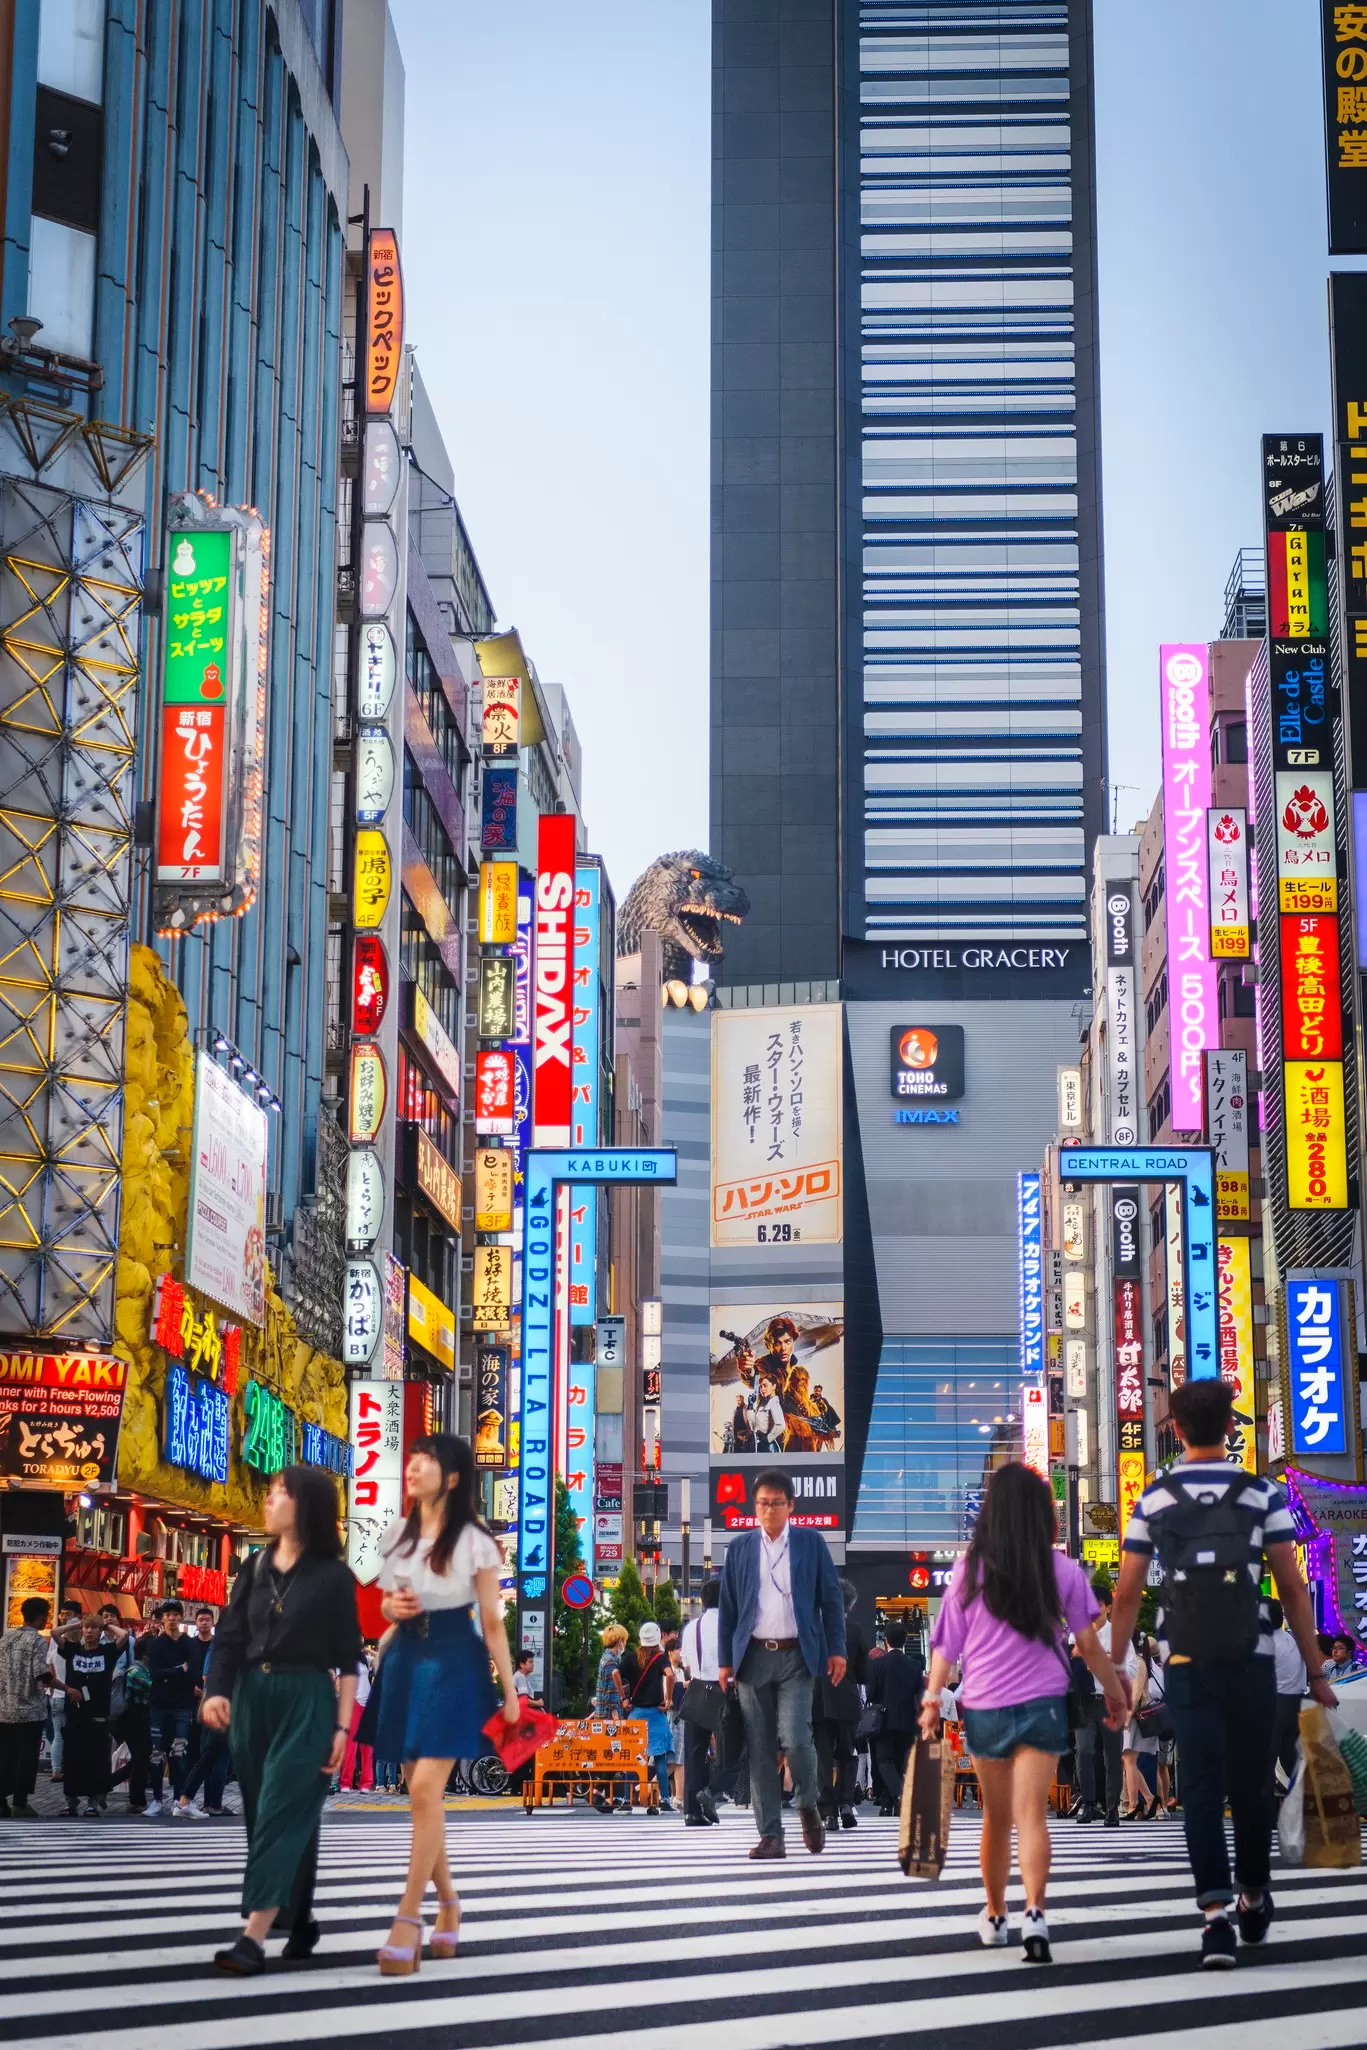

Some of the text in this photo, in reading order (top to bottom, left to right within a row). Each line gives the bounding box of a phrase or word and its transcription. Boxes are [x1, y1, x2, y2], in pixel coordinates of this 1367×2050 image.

[372, 249, 394, 261] 新宿
[1269, 480, 1283, 488] 8F
[1289, 524, 1303, 532] 7F
[1290, 537, 1308, 615] Garam
[193, 599, 204, 609] と
[173, 607, 223, 628] サラダ
[192, 626, 203, 638] と
[1279, 622, 1320, 633] ガラム
[170, 636, 225, 659] スイーツ
[1275, 644, 1326, 654] New Club
[486, 679, 507, 689] 海鮮
[1303, 658, 1325, 725] Castle
[486, 689, 516, 699] 居酒屋
[361, 703, 385, 716] 6F
[1279, 669, 1301, 744] Elle de
[179, 710, 212, 727] 新宿
[493, 743, 507, 754] 8F
[1291, 751, 1316, 763] 7F
[175, 727, 212, 862] ひょうたん
[364, 811, 378, 820] 5F
[1172, 758, 1205, 961] オープンスペース
[1284, 849, 1331, 866] 鳥メロ
[181, 867, 200, 878] 7F
[359, 857, 385, 904] 虎の子
[1219, 868, 1239, 922] 鳥メロ
[1284, 881, 1331, 893] 生ビール
[495, 872, 512, 932] 鳥貴族
[357, 915, 376, 923] 4F
[1108, 894, 1130, 955] Booth
[1300, 919, 1319, 933] 5F
[1214, 929, 1245, 937] 生ビール
[1218, 937, 1246, 950] 199
[882, 949, 1070, 968] HOTEL GRACERY
[536, 872, 574, 1068] SHIDAX
[484, 961, 507, 1027] 山内農場
[1295, 937, 1326, 1056] 豊後高田どり
[376, 995, 384, 1017] 3F
[490, 1025, 502, 1035] 5F
[1115, 974, 1129, 1118] ネットカフェ & カプセル
[1232, 1053, 1244, 1063] 4F
[899, 1072, 934, 1084] TOHO
[358, 1060, 375, 1131] お好み焼き
[766, 1033, 785, 1162] スター・ウォーズ
[899, 1084, 948, 1094] CINEMAS
[1065, 1081, 1077, 1121] 東京ビル
[1301, 1085, 1332, 1129] 酒場
[895, 1109, 960, 1124] IMAX
[1211, 1059, 1228, 1167] キタノイチバ
[486, 1121, 502, 1133] 4F
[1118, 1131, 1131, 1142] 8F
[1067, 1158, 1188, 1169] CENTRAL ROAD
[1307, 1144, 1327, 1197] 280
[723, 1169, 830, 1212] ハン・ソロ
[357, 1172, 372, 1235] とらそば
[775, 1202, 803, 1214] WARS
[1022, 1182, 1039, 1236] 747
[485, 1215, 503, 1227] 3F
[744, 1208, 773, 1220] STAR
[757, 1224, 791, 1243] 6.29
[1114, 1199, 1138, 1262] Booth
[352, 1239, 369, 1249] 1F
[350, 1268, 371, 1279] 新宿
[483, 1248, 503, 1304] お好み焼
[348, 1279, 372, 1337] かっぱ
[1023, 1241, 1042, 1365] カラオケランド
[1191, 1241, 1212, 1360] ゴジラ
[475, 1306, 508, 1320] 大阪家
[1123, 1282, 1134, 1340] 手作り居酒屋
[350, 1344, 368, 1355] B1
[55, 1357, 125, 1387] YAKI
[1296, 1286, 1338, 1445] カラオケ
[481, 1354, 501, 1406] 海の家
[524, 1215, 549, 1535] GODZILLA ROAD
[1116, 1342, 1142, 1412] 甘太郎
[24, 1387, 47, 1398] with
[50, 1388, 121, 1404] Free-Flowing
[22, 1401, 37, 1413] for
[40, 1402, 47, 1412] 2
[50, 1402, 82, 1415] hours
[84, 1404, 120, 1417] ¥2,500
[384, 1384, 400, 1452] 大衆酒場
[1122, 1422, 1142, 1435] 4F
[19, 1421, 105, 1460] とらぢゅう
[1122, 1436, 1142, 1449] 3F
[355, 1392, 382, 1507] トラノコ
[23, 1463, 97, 1476] TORADYU 2F
[597, 1499, 620, 1508] Cafe
[1313, 1510, 1367, 1521] KARAOKE
[6, 1539, 59, 1549] 防犯カメラ作動中
[1152, 1577, 1162, 1585] 12
[553, 1749, 631, 1761] 歩行者専用
